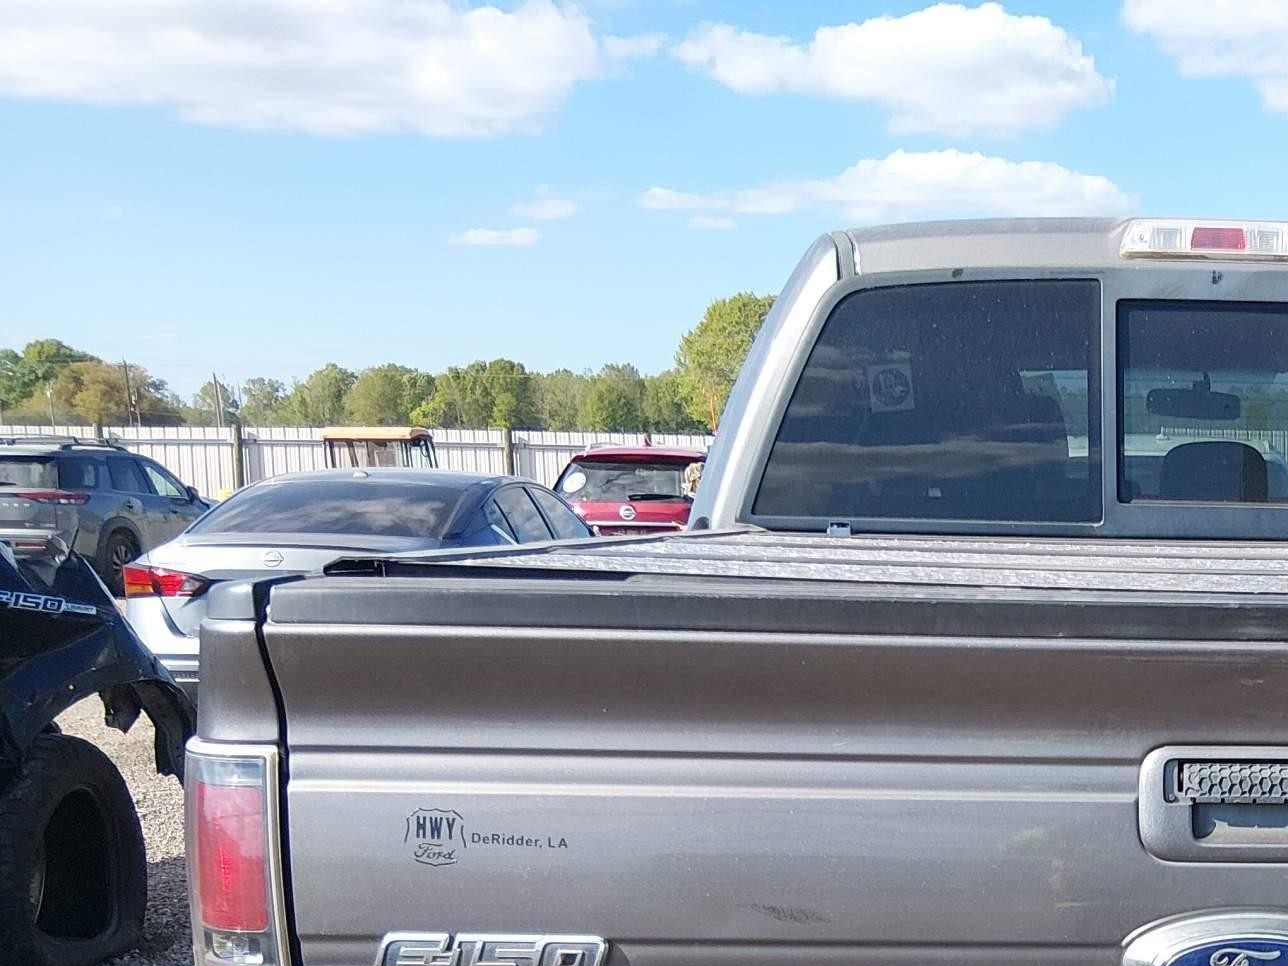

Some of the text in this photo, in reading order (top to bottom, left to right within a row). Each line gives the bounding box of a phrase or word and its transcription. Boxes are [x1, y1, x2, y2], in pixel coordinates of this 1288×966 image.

[416, 816, 456, 840] HWY
[471, 832, 568, 849] DeRidder, LA
[414, 843, 456, 860] Ford
